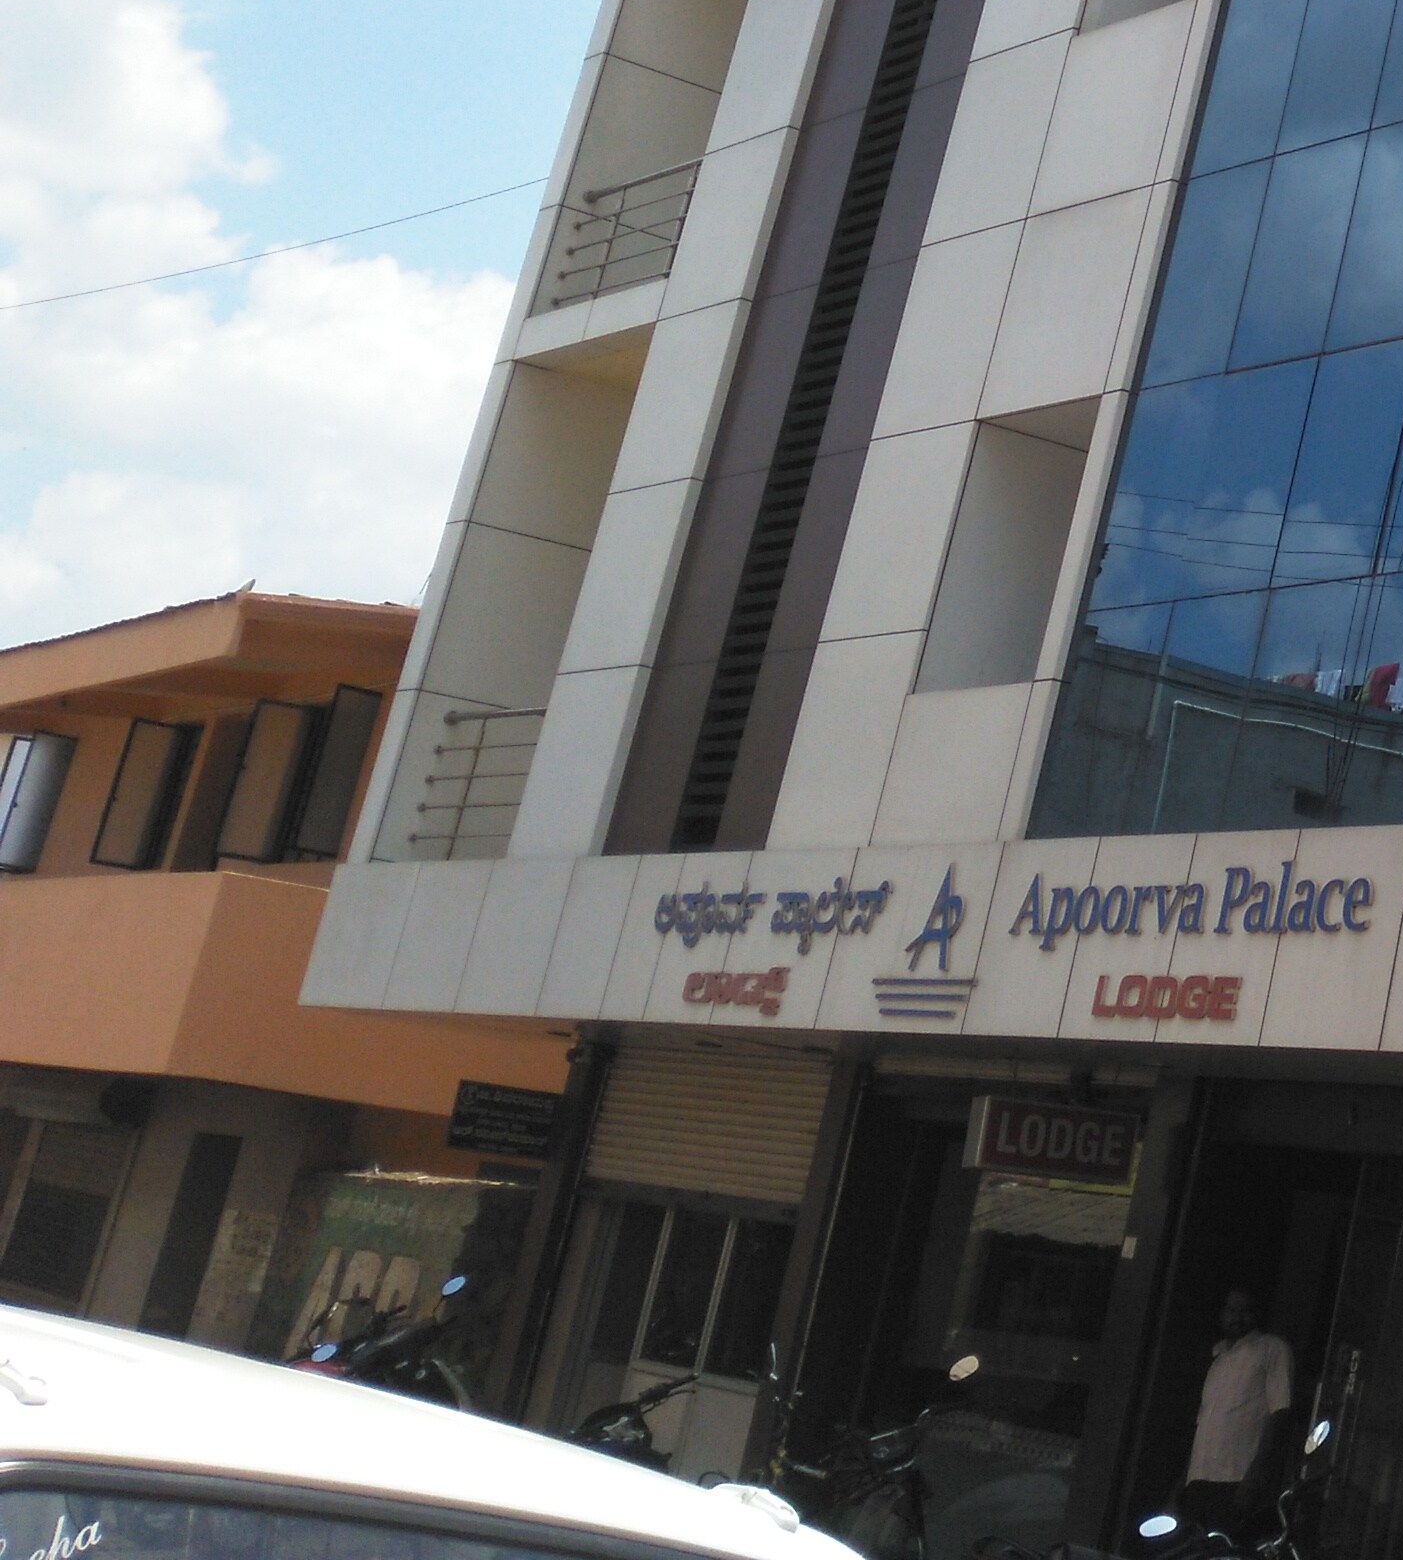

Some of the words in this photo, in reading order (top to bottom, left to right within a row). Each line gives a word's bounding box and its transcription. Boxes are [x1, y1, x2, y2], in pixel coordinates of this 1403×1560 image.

[1008, 871, 1206, 952] Apoorva
[1213, 859, 1374, 935] Palace
[1092, 974, 1244, 1022] LODGE
[996, 1111, 1127, 1167] LODGE
[1344, 1349, 1361, 1395] PUSH
